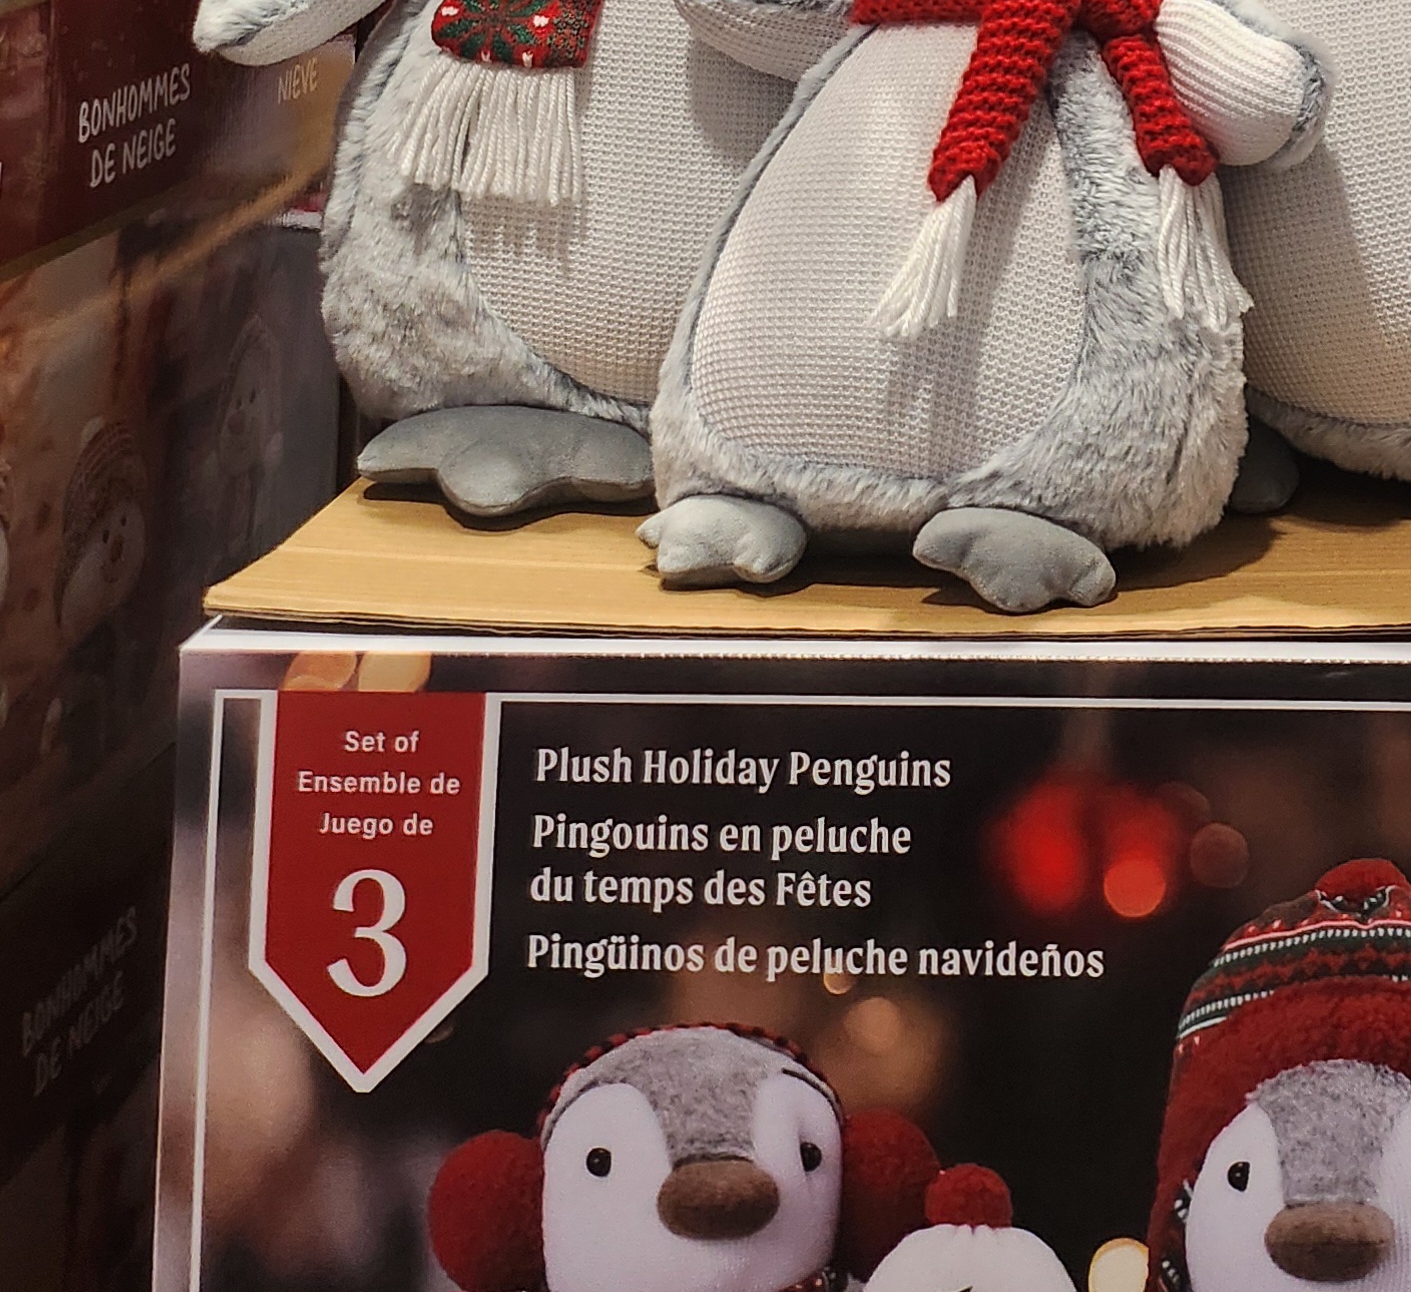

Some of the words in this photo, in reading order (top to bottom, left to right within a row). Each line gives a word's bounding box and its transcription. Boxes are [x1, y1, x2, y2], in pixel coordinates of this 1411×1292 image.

[78, 63, 191, 143] BONHOMMES
[277, 57, 319, 104] NIEVE
[90, 143, 116, 188] DE
[122, 119, 177, 174] NEIGE
[345, 731, 385, 752] Set
[395, 731, 419, 752] of
[299, 771, 420, 793] Ensemble
[430, 773, 459, 794] de
[537, 747, 631, 782] Plush
[643, 749, 779, 793] Holiday
[789, 751, 950, 795] Penguins
[320, 813, 393, 839] Juego
[403, 813, 432, 835] de
[534, 813, 708, 857] Pingouins
[720, 825, 760, 851] en
[771, 817, 910, 860] peluche
[531, 867, 572, 901] du
[584, 871, 693, 912] temps
[704, 870, 765, 905] des
[776, 872, 870, 907] Fêtes
[327, 869, 406, 996] 3
[528, 933, 704, 978] Pingüinos
[715, 937, 757, 972] de
[766, 938, 907, 982] peluche
[919, 941, 1103, 977] navideños
